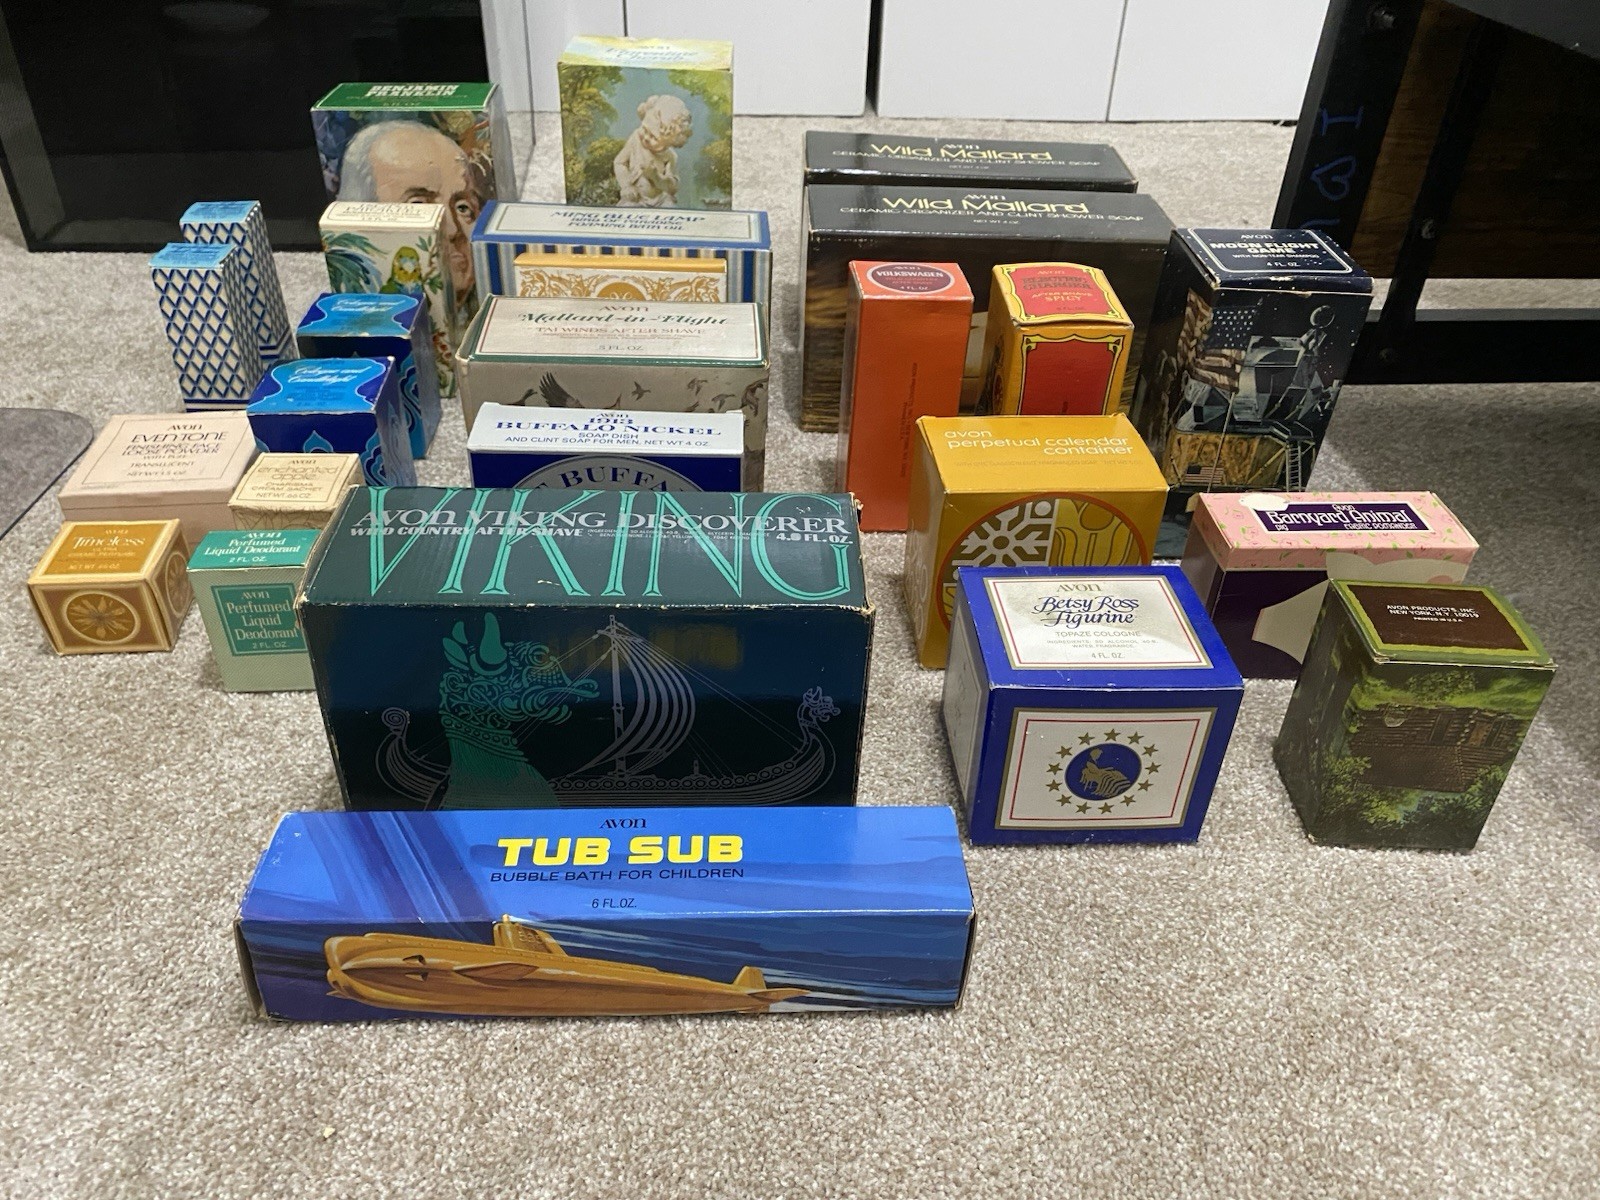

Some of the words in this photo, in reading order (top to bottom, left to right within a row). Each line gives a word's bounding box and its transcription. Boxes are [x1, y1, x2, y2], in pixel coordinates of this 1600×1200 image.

[870, 143, 931, 156] Wild
[940, 149, 1052, 160] Mallard
[882, 197, 953, 210] Wild
[961, 200, 1090, 213] Mallard
[552, 211, 599, 219] MING
[903, 208, 975, 216] ORGANIZER
[519, 313, 728, 326] Mallard-in-Flight
[497, 422, 616, 431] BUFFALO
[627, 426, 721, 435] NICKEL
[944, 430, 992, 438] avon
[948, 438, 1040, 449] perpetual
[1045, 437, 1128, 447] calendar
[1043, 445, 1133, 455] container
[257, 466, 339, 474] enchanted
[271, 473, 316, 481] apple
[354, 509, 457, 526] AVON
[466, 511, 607, 528] VIKING
[617, 513, 851, 534] DISCOVERER
[1265, 510, 1350, 526] Barnyard
[1350, 509, 1413, 523] Animal
[350, 526, 395, 536] WID
[804, 534, 827, 542] FL.
[829, 534, 854, 544] OZ.
[73, 536, 146, 549] Timeless
[229, 538, 286, 547] Perfumed
[368, 486, 850, 600] VIKING
[204, 546, 241, 557] Liquid
[243, 545, 301, 554] Deodorant
[1057, 584, 1102, 592] AVON
[241, 591, 270, 599] AVON
[226, 600, 291, 614] Perfumed
[1032, 596, 1093, 614] Betsy
[1094, 596, 1140, 613] Ross
[241, 613, 282, 629] Liquid
[1040, 610, 1135, 629] Figurine
[234, 627, 298, 640] Deodorant
[600, 818, 646, 829] AVON
[497, 838, 612, 867] TUB
[628, 835, 744, 865] SUB
[490, 872, 560, 883] BUBBLE
[565, 870, 612, 881] BATH
[619, 870, 653, 880] FOR
[659, 869, 744, 880] CHILDREN
[592, 898, 599, 908] 6
